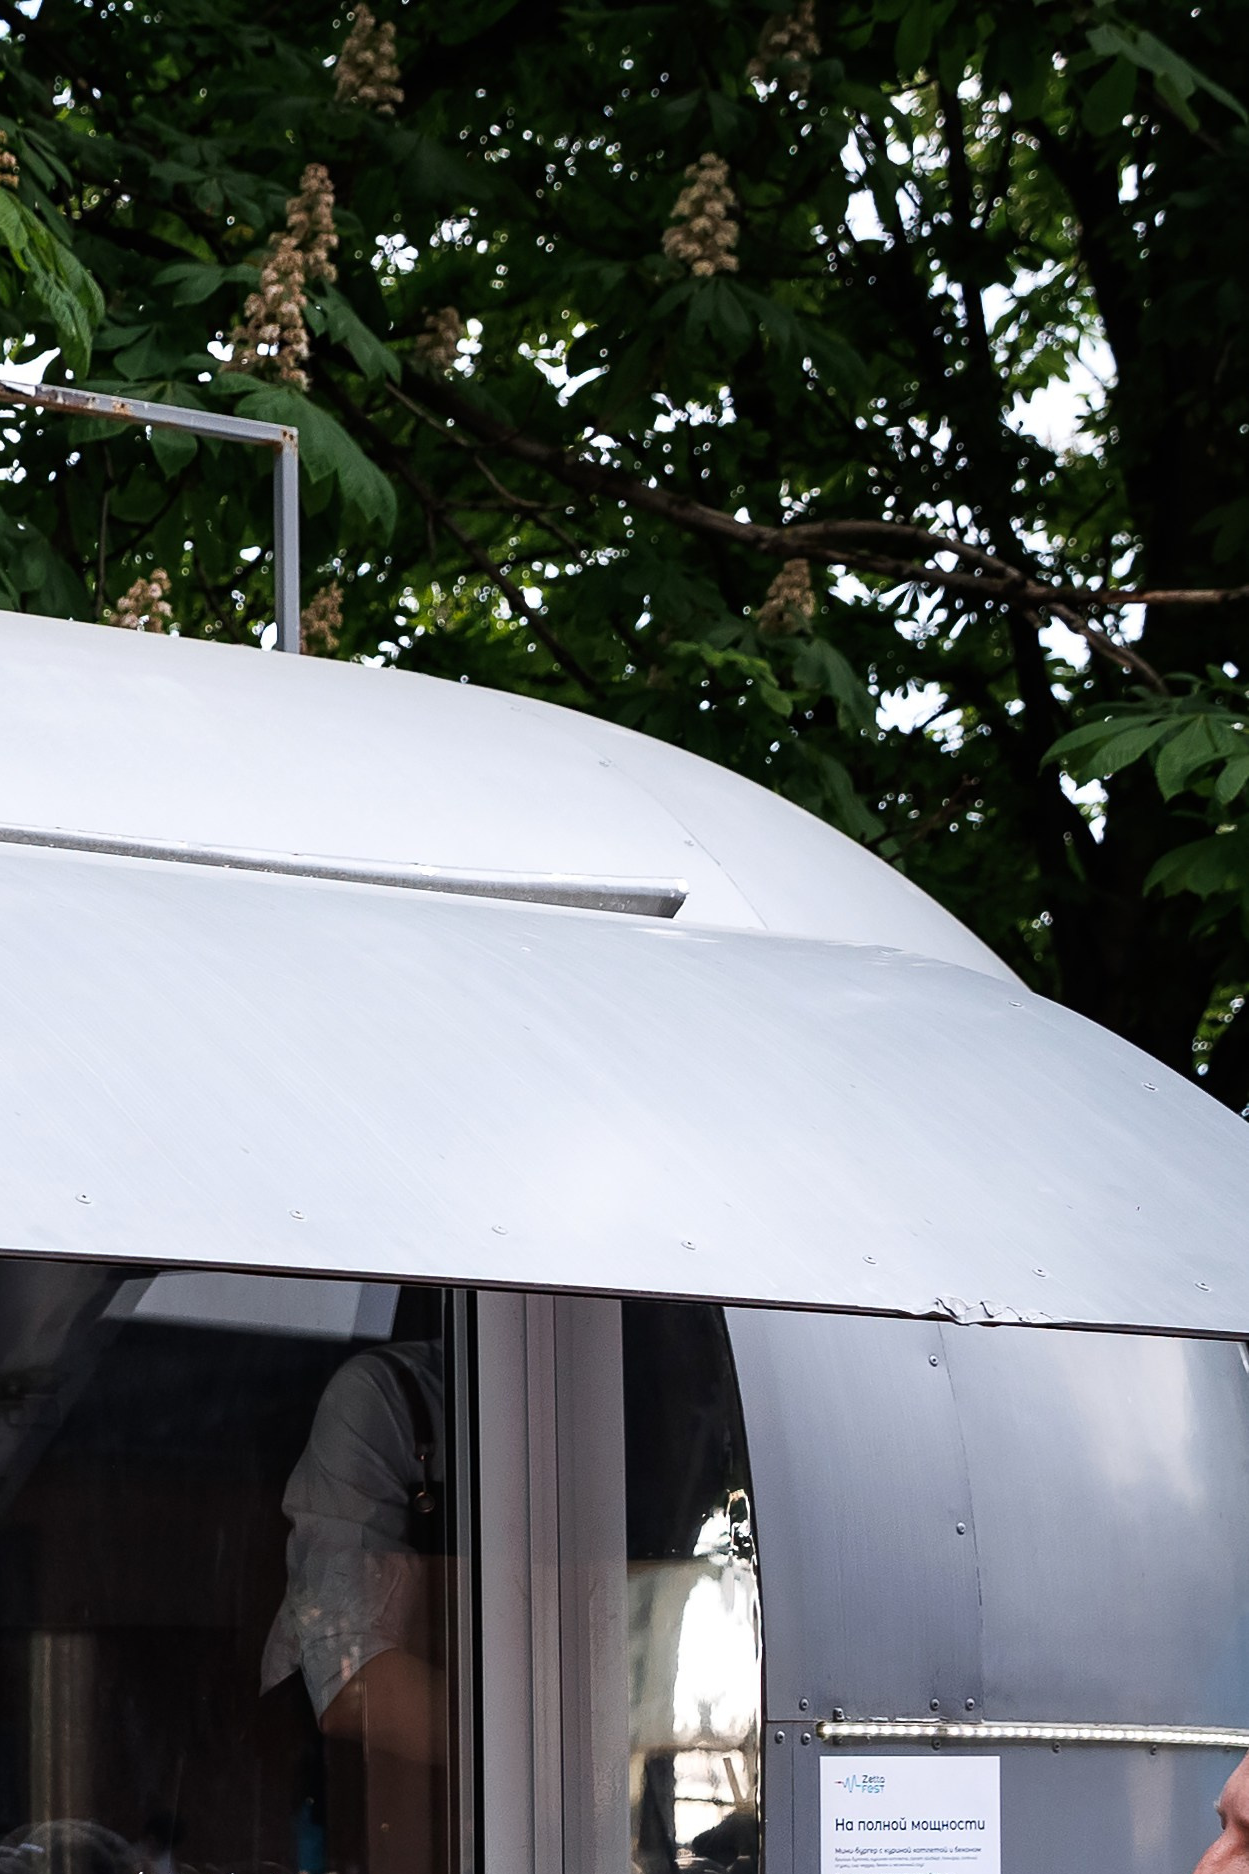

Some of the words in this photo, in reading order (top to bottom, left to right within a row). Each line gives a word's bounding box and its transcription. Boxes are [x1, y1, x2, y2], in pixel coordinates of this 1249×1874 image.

[835, 1818, 854, 1831] На
[858, 1816, 907, 1831] полной
[911, 1819, 986, 1832] мощности
